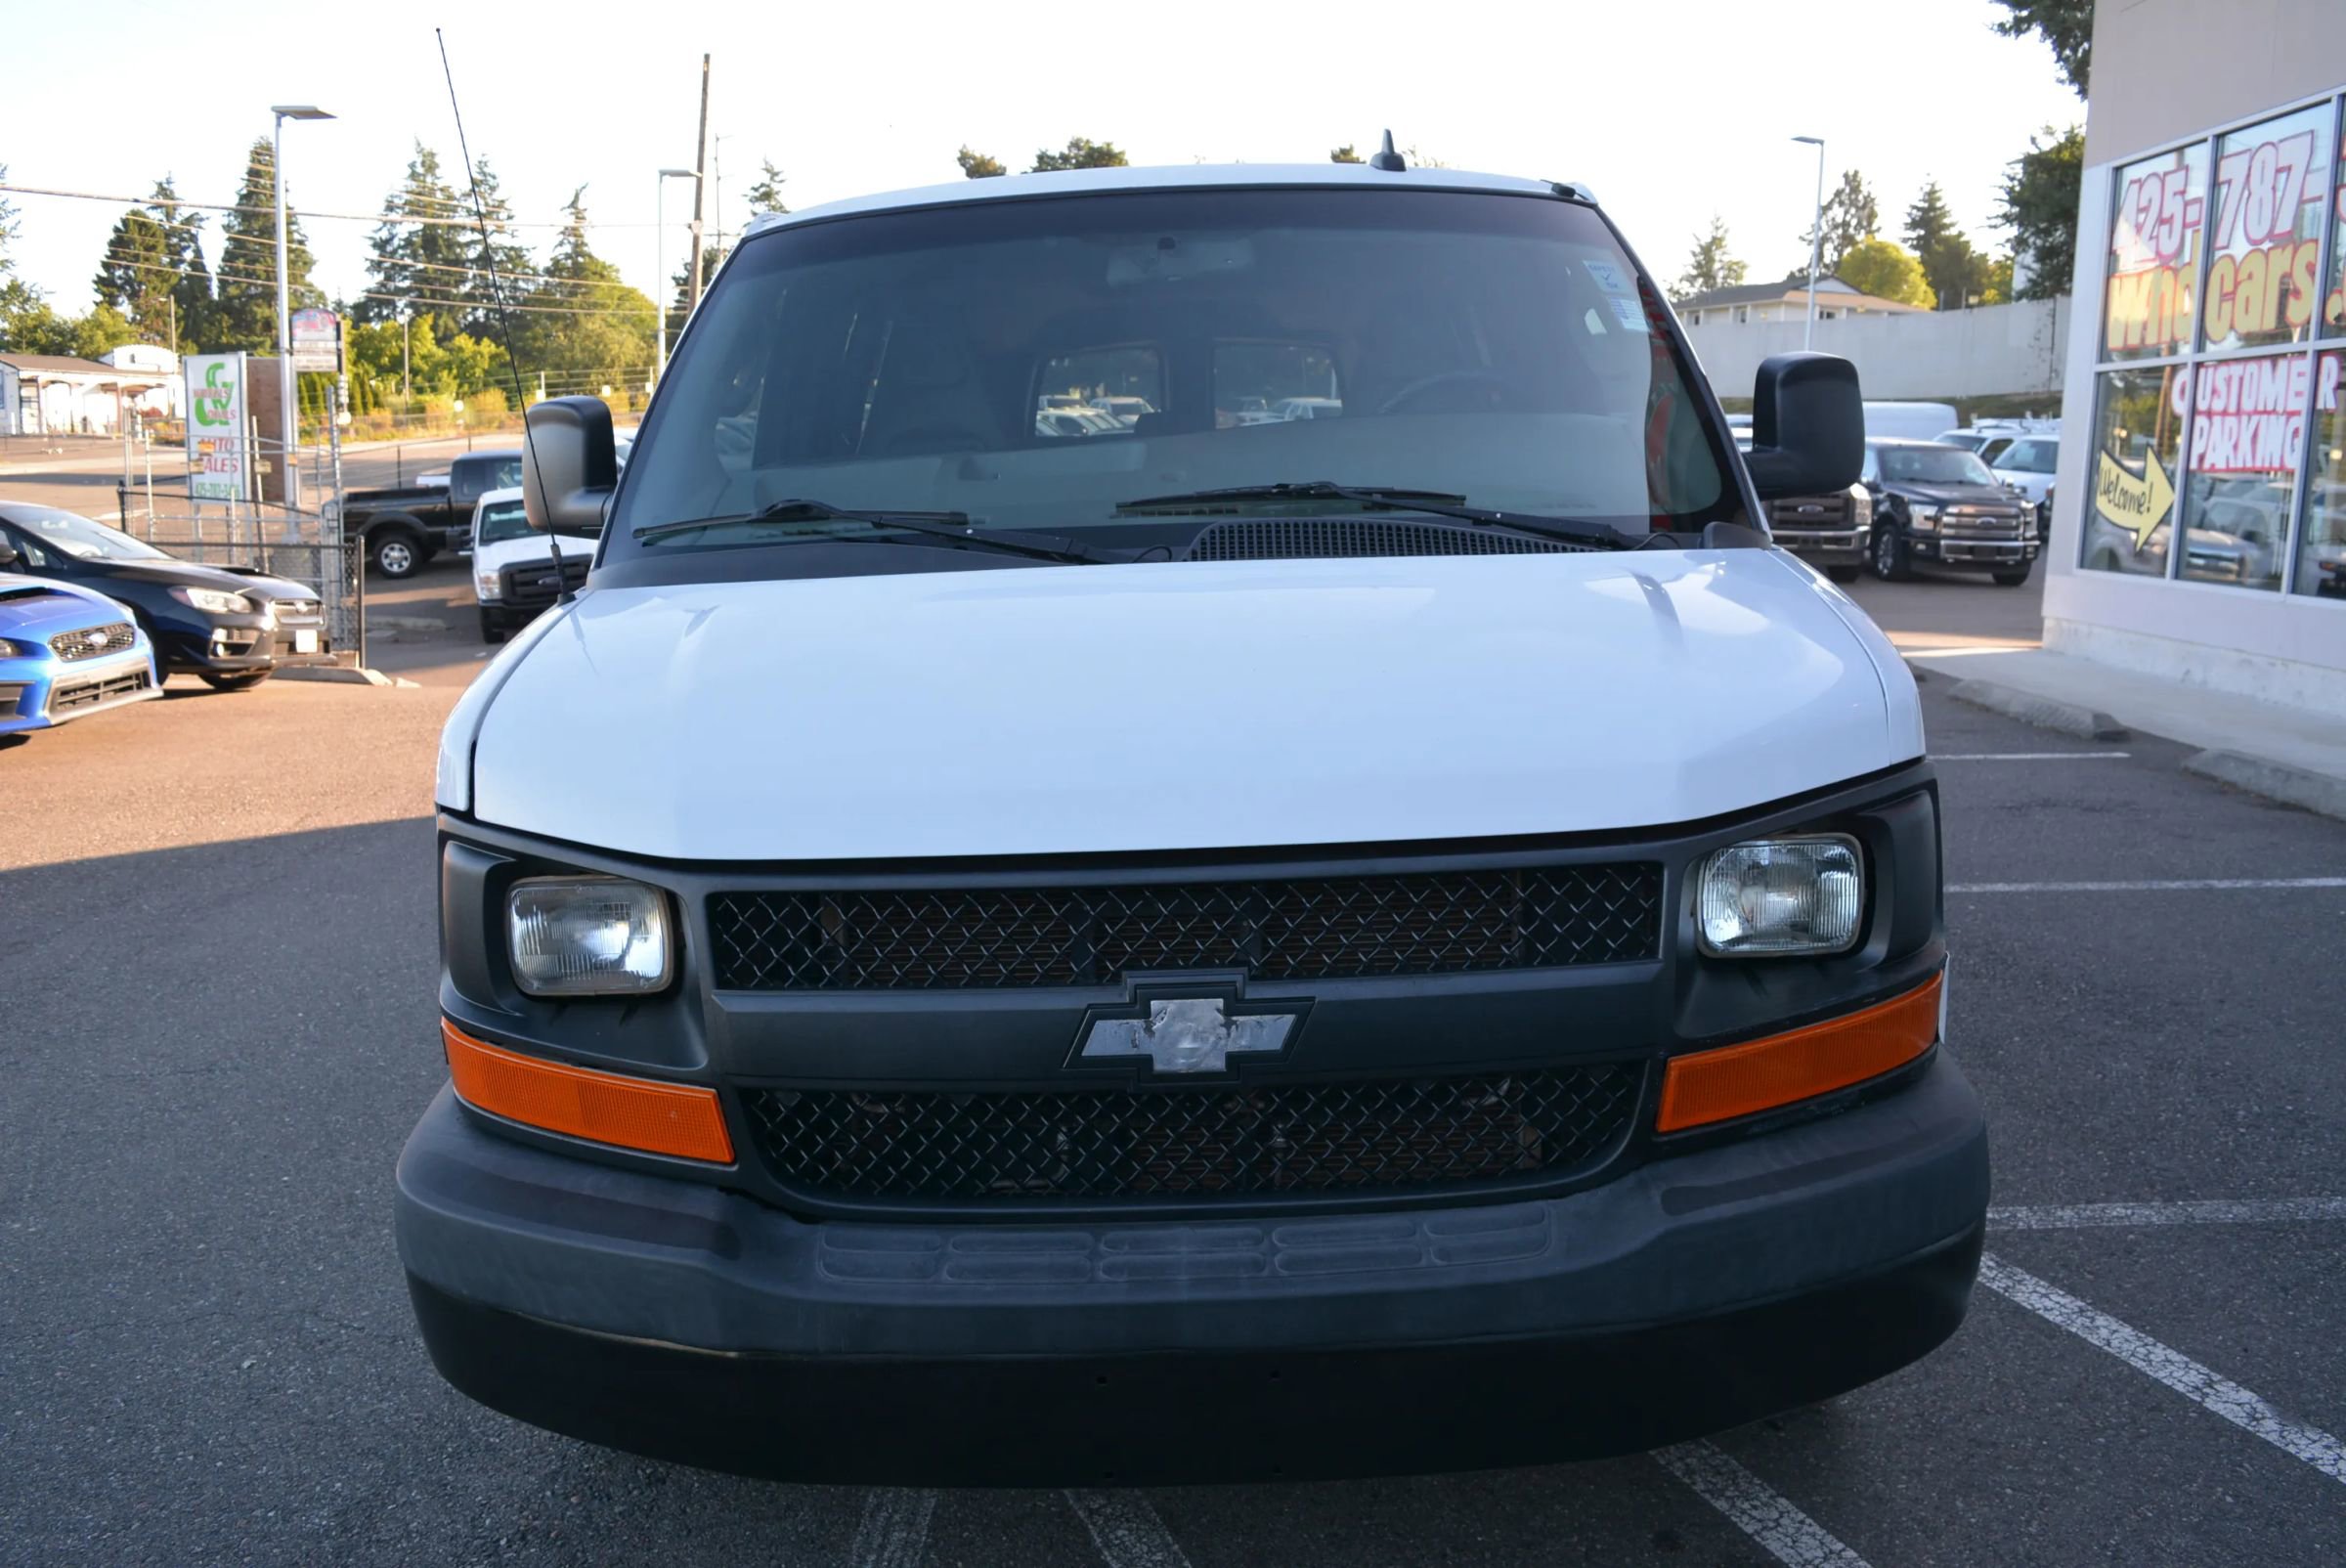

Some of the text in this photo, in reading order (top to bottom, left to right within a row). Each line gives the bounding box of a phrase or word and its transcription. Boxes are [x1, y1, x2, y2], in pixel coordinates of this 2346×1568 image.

[2171, 351, 2341, 416] CUSTOMER
[196, 457, 239, 473] ALES
[2189, 414, 2301, 472] PARKING
[2099, 467, 2154, 515] Welcome!
